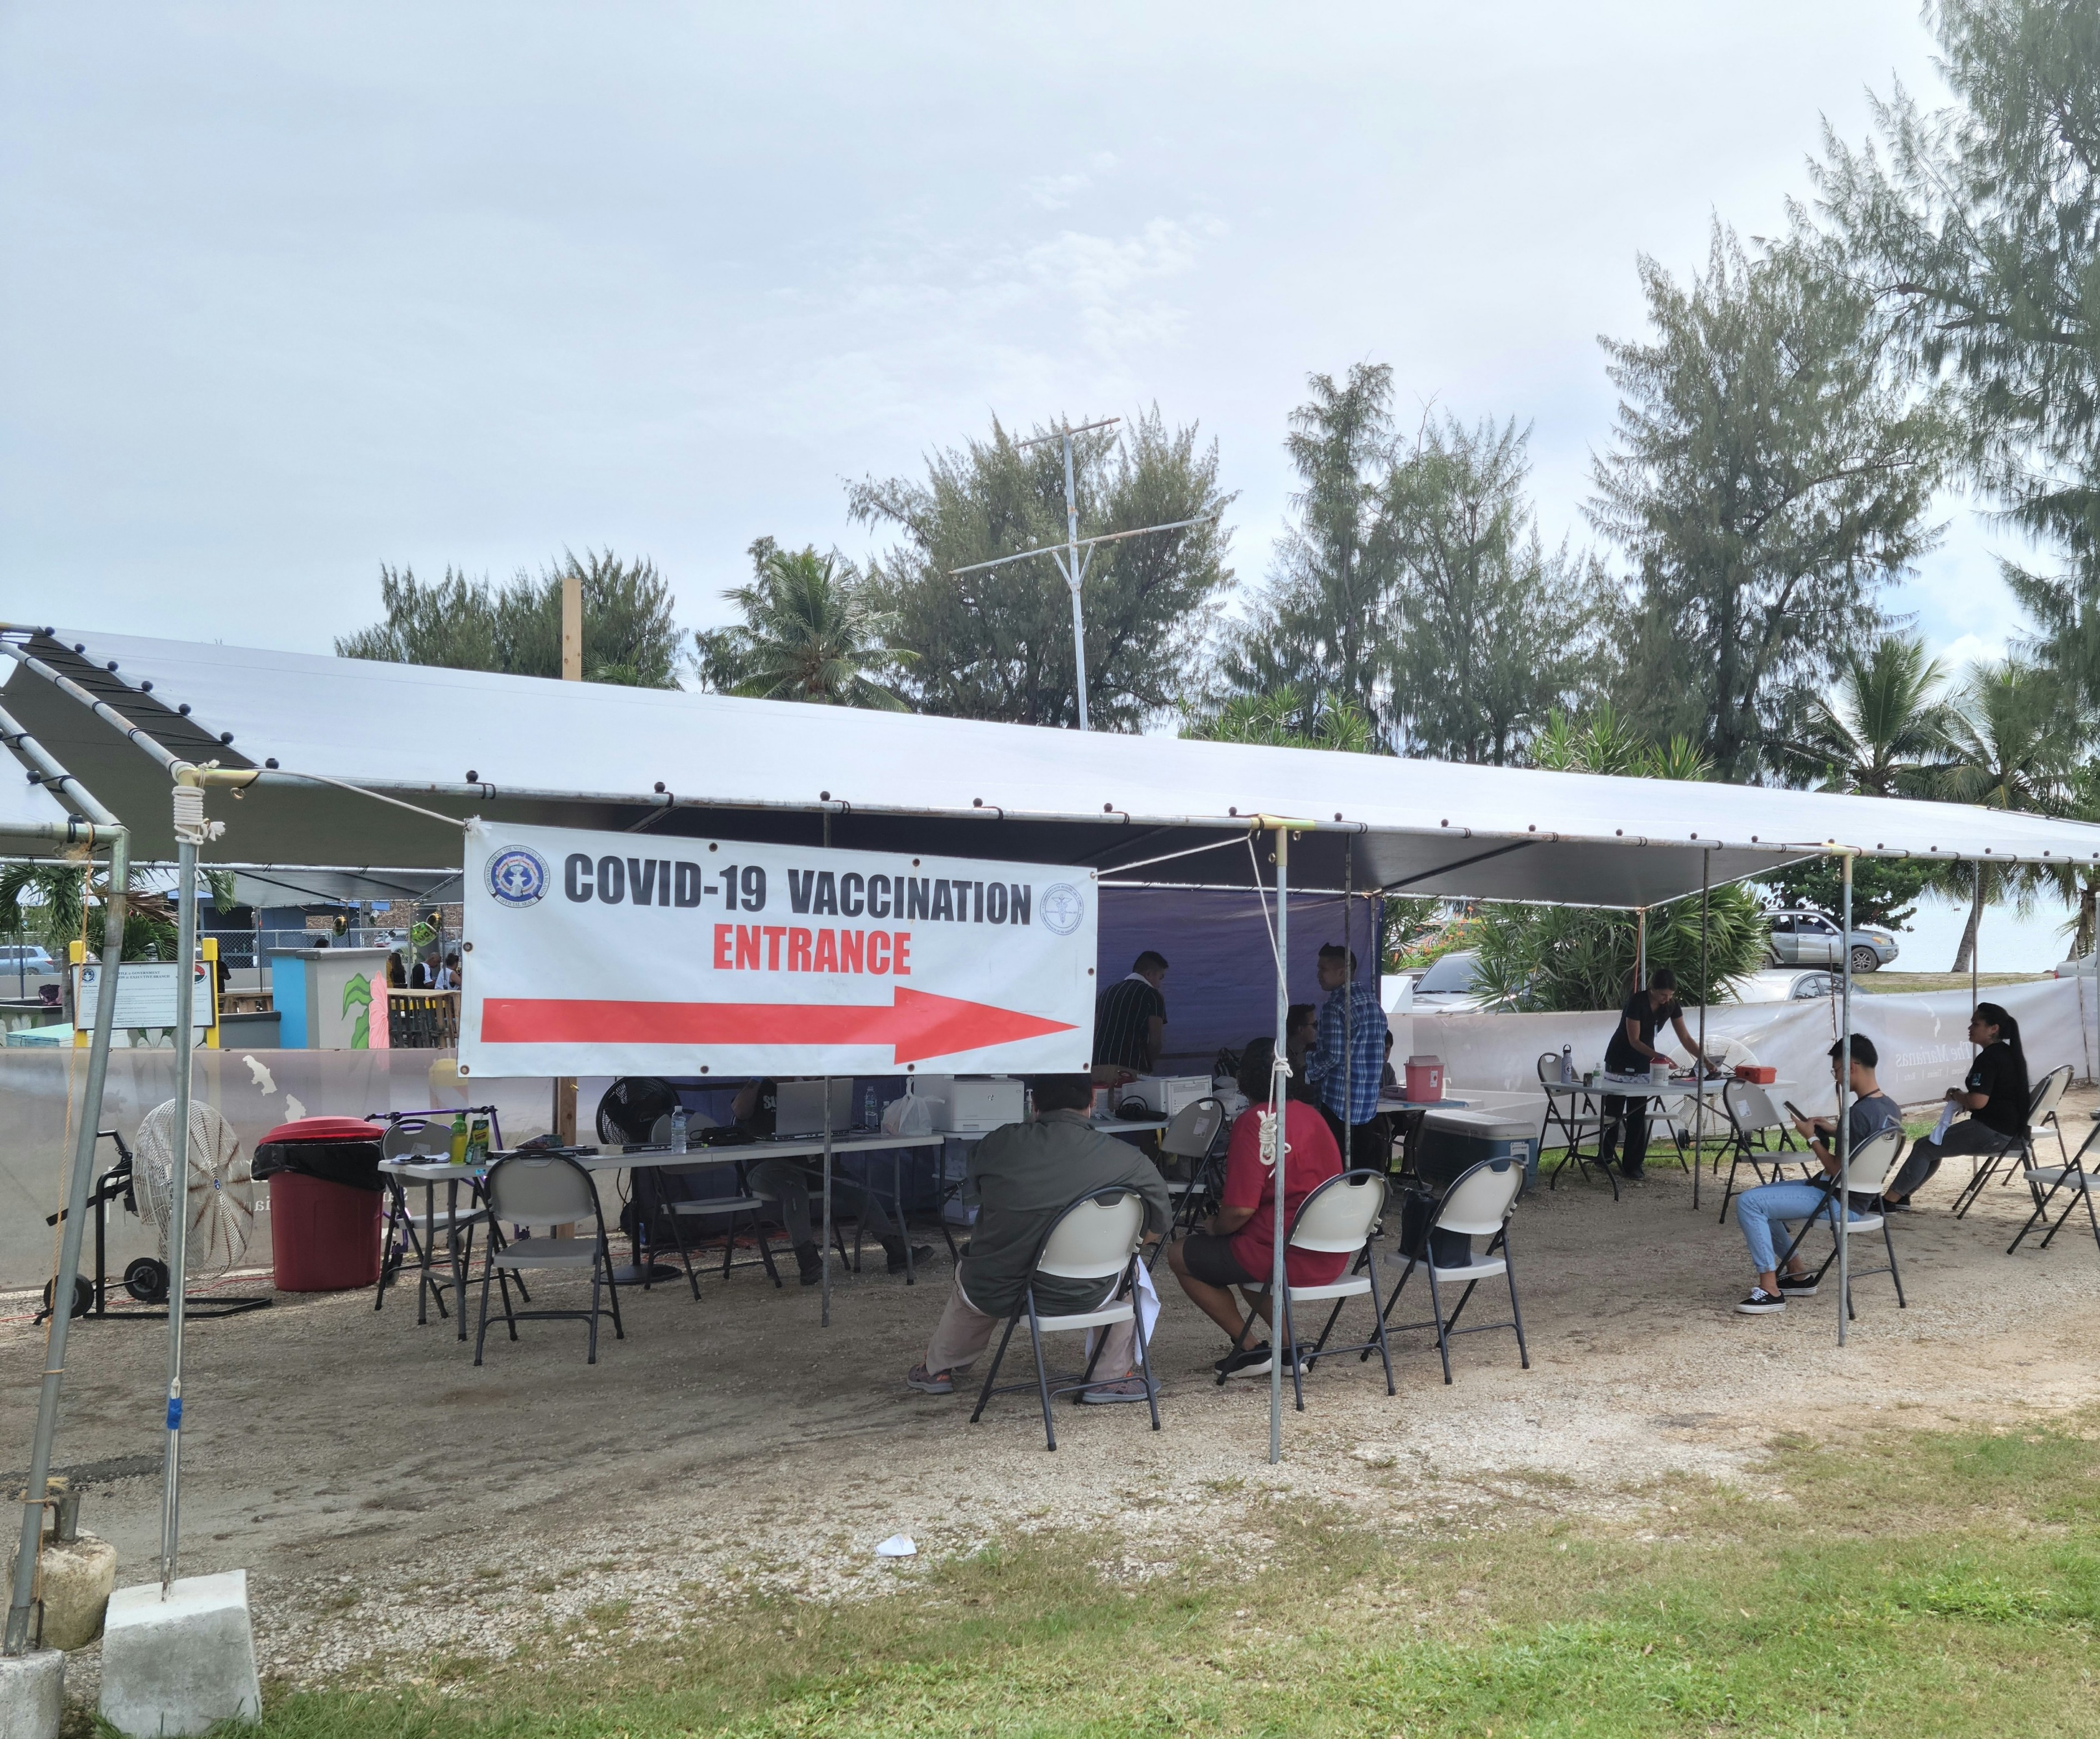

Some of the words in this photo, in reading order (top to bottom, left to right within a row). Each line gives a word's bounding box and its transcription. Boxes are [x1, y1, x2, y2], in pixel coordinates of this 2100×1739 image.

[513, 846, 537, 858] NORTHERN
[537, 856, 548, 876] MARIANA
[539, 876, 548, 896] ISLANDS
[564, 852, 767, 912] COVID-19
[787, 868, 1032, 926] VACCINATION
[500, 898, 521, 907] OFFICIAL
[713, 923, 911, 976] ENTRANCE
